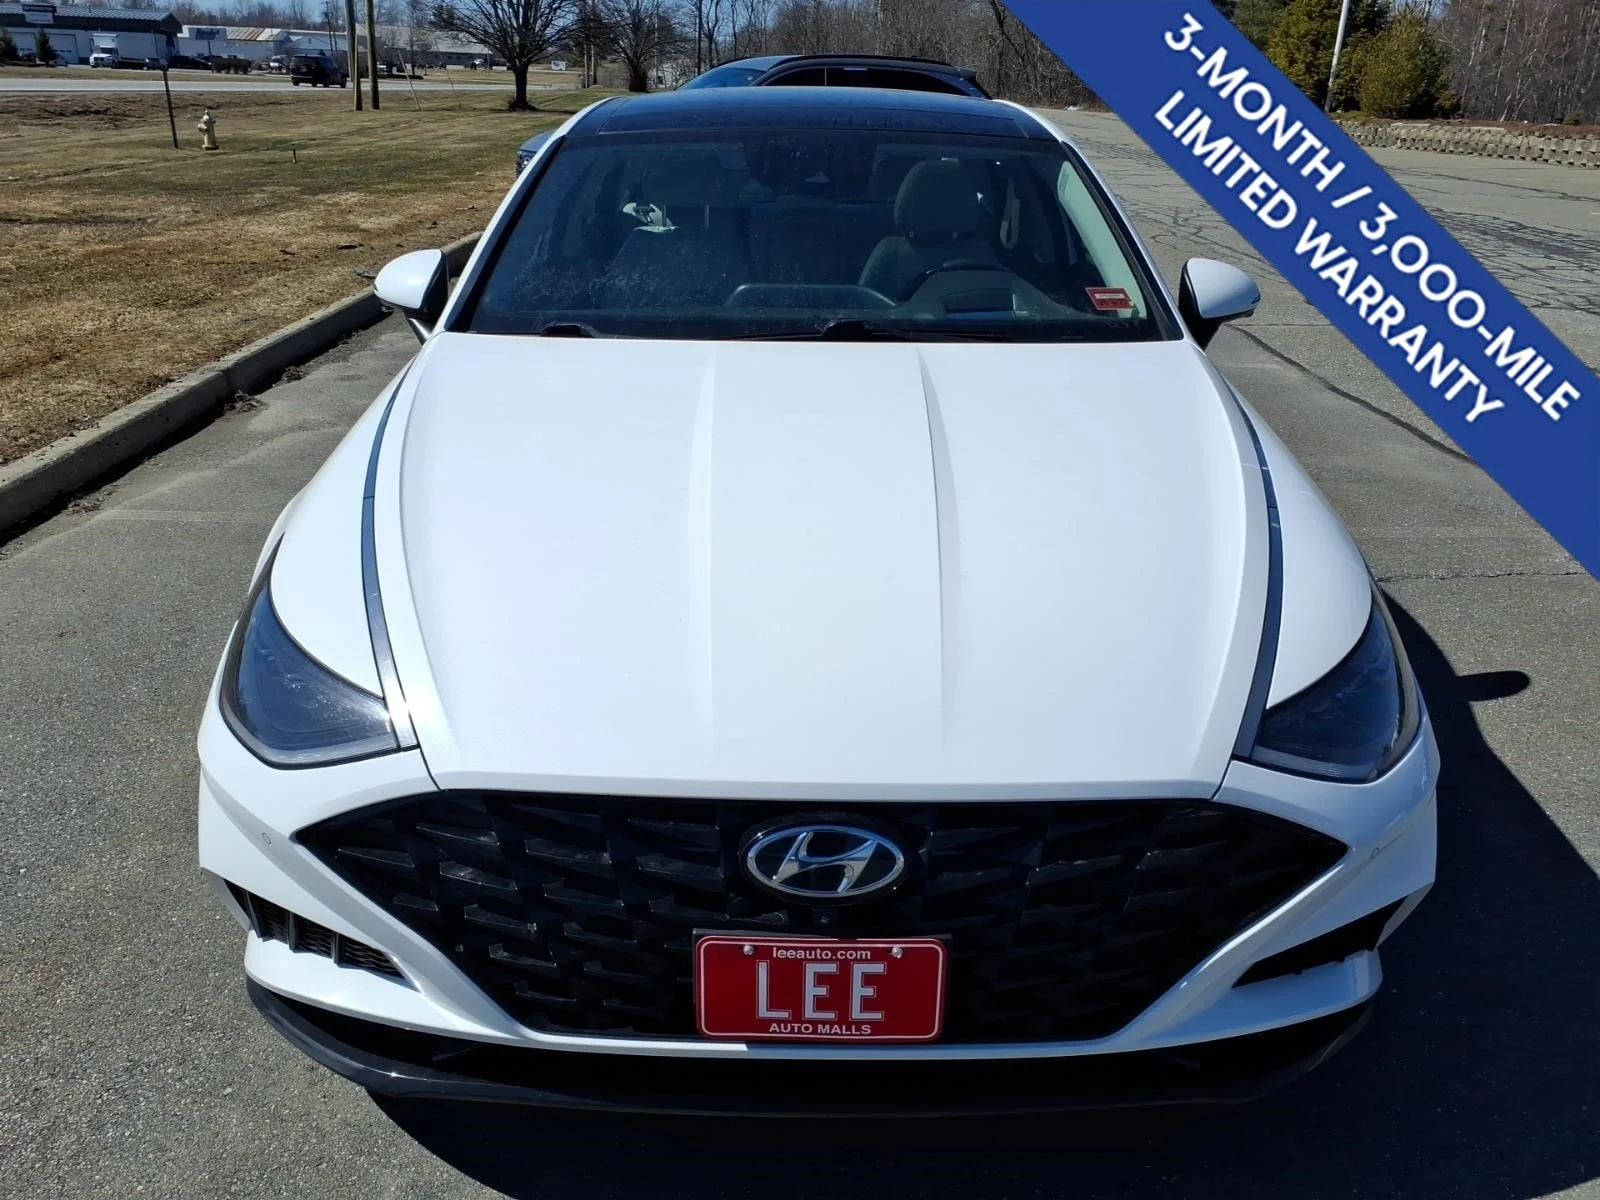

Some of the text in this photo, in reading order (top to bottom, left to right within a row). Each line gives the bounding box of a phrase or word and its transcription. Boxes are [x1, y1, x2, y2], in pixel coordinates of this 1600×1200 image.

[773, 947, 871, 961] leeauto.com
[756, 960, 887, 1020] LEE
[769, 1023, 872, 1035] AUTO MALLS
